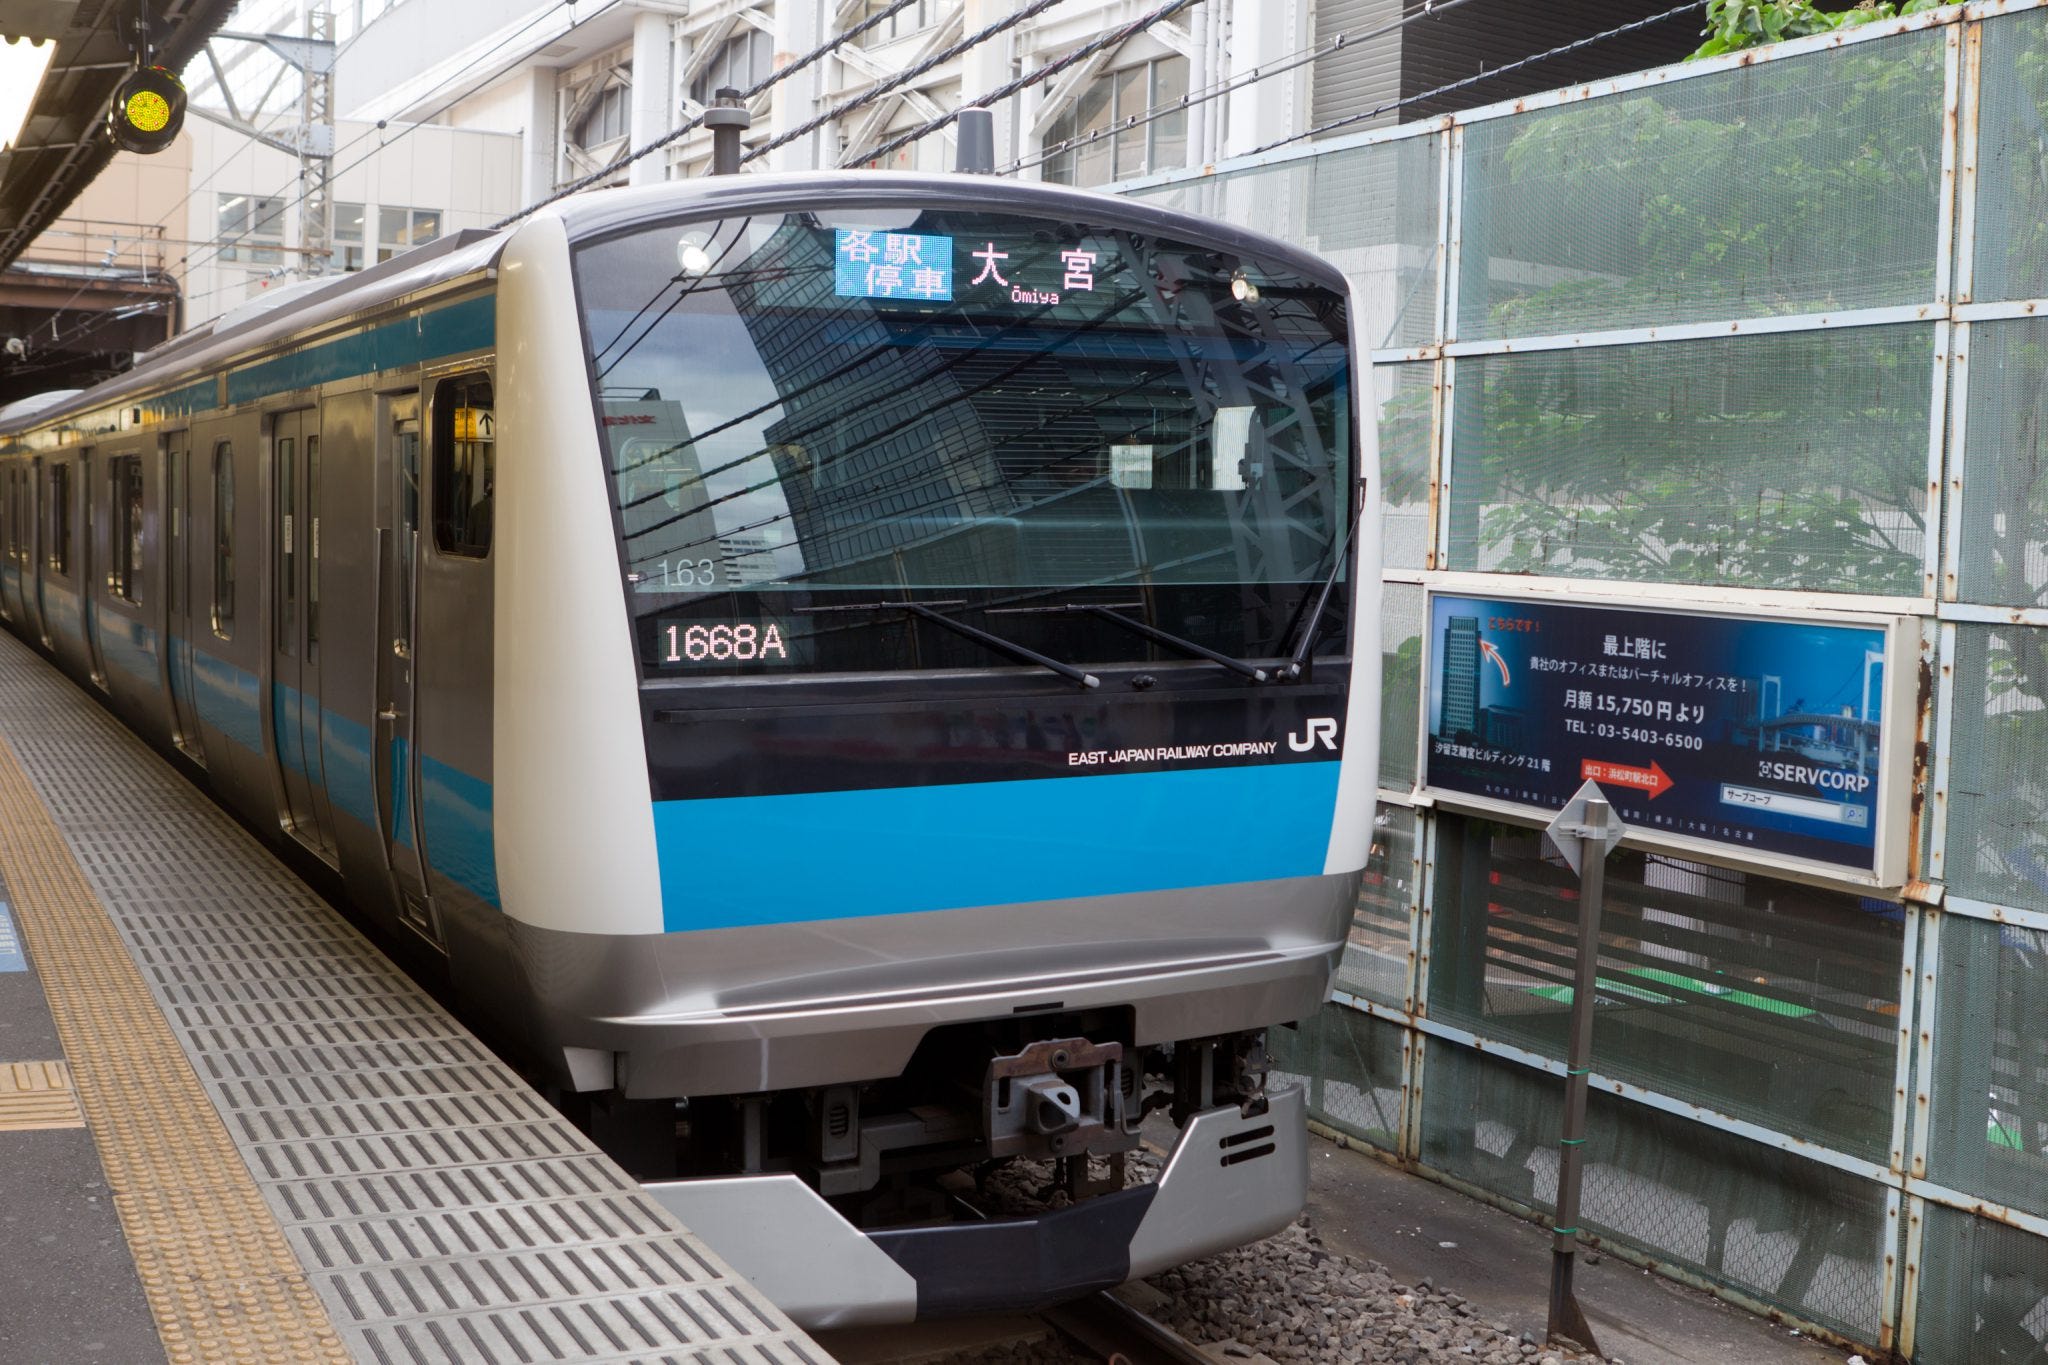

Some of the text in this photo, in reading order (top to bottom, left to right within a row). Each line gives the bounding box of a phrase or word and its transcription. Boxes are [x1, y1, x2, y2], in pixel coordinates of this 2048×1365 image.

[840, 230, 922, 265] 各駅
[864, 263, 948, 298] 停車
[657, 558, 715, 586] 163
[666, 623, 786, 661] 1668A
[1603, 634, 1667, 660] 最上階に
[1288, 717, 1338, 752] JR
[1068, 741, 1278, 766] EAST JAPAN RAILWAY COMPANY
[1773, 763, 1870, 793] SERVCORP
